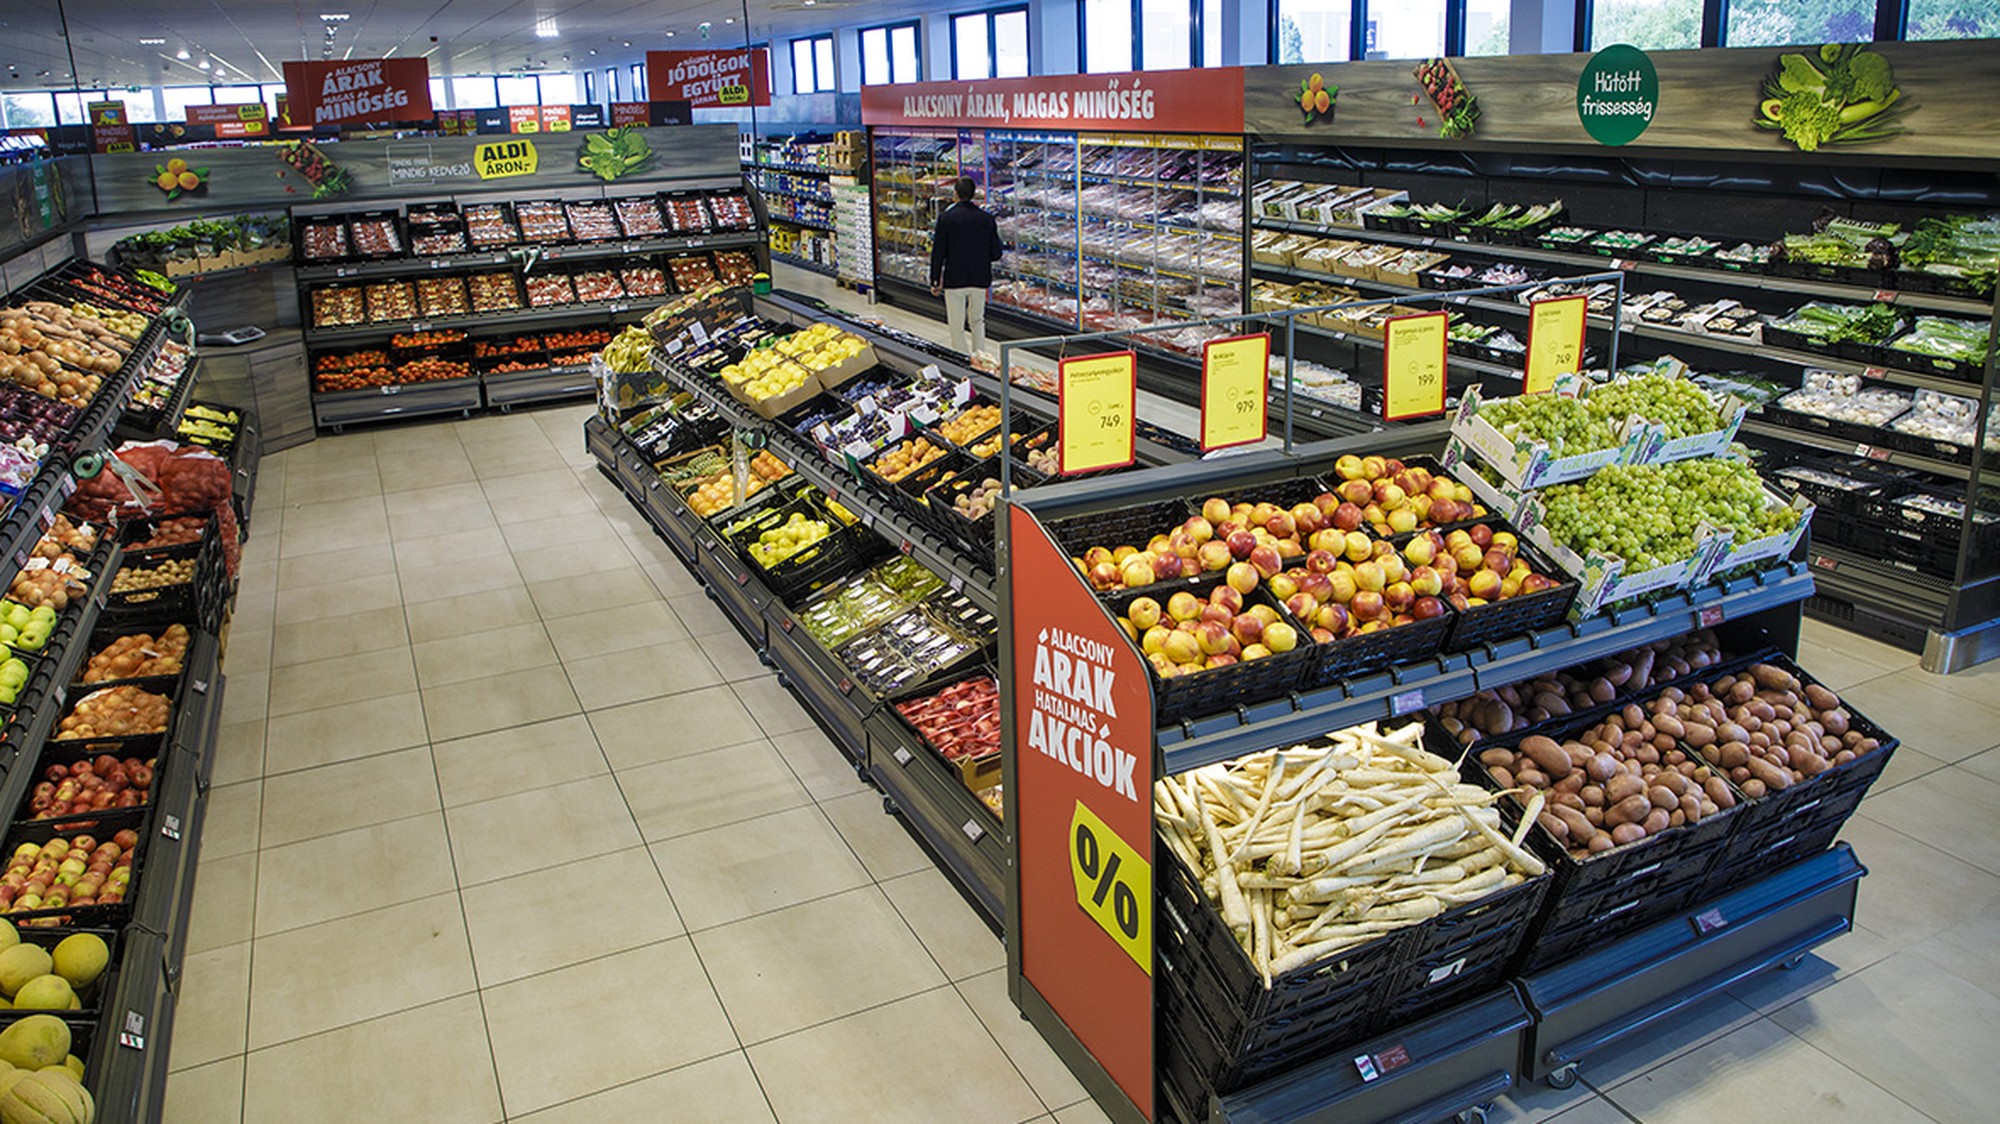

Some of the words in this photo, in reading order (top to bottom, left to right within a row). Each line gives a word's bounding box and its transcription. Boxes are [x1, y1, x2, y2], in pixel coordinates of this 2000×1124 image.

[322, 69, 384, 96] ÁRAK
[335, 61, 382, 76] ALACSONY
[667, 62, 686, 86] JÓ
[687, 54, 749, 80] DOLGOK
[1594, 70, 1642, 92] Hűtött
[682, 70, 741, 98] EGYÜTT
[722, 87, 745, 95] ALDI
[315, 86, 409, 123] MINŐSÉG
[323, 92, 355, 105] MAGAS
[903, 95, 963, 119] ALACSONY
[966, 85, 1010, 123] ÁRAK,
[1013, 91, 1068, 119] MAGAS
[1073, 78, 1155, 120] MINŐSÉG
[1582, 94, 1653, 122] frissesség
[482, 142, 529, 162] ALDI
[391, 167, 426, 179] MINDIG
[1051, 627, 1115, 668] ALACSONY
[1033, 627, 1118, 719] ÁRAK
[1035, 689, 1097, 734] HATALMAS
[1028, 708, 1138, 803] AKCIÓK
[1076, 823, 1139, 940] %
